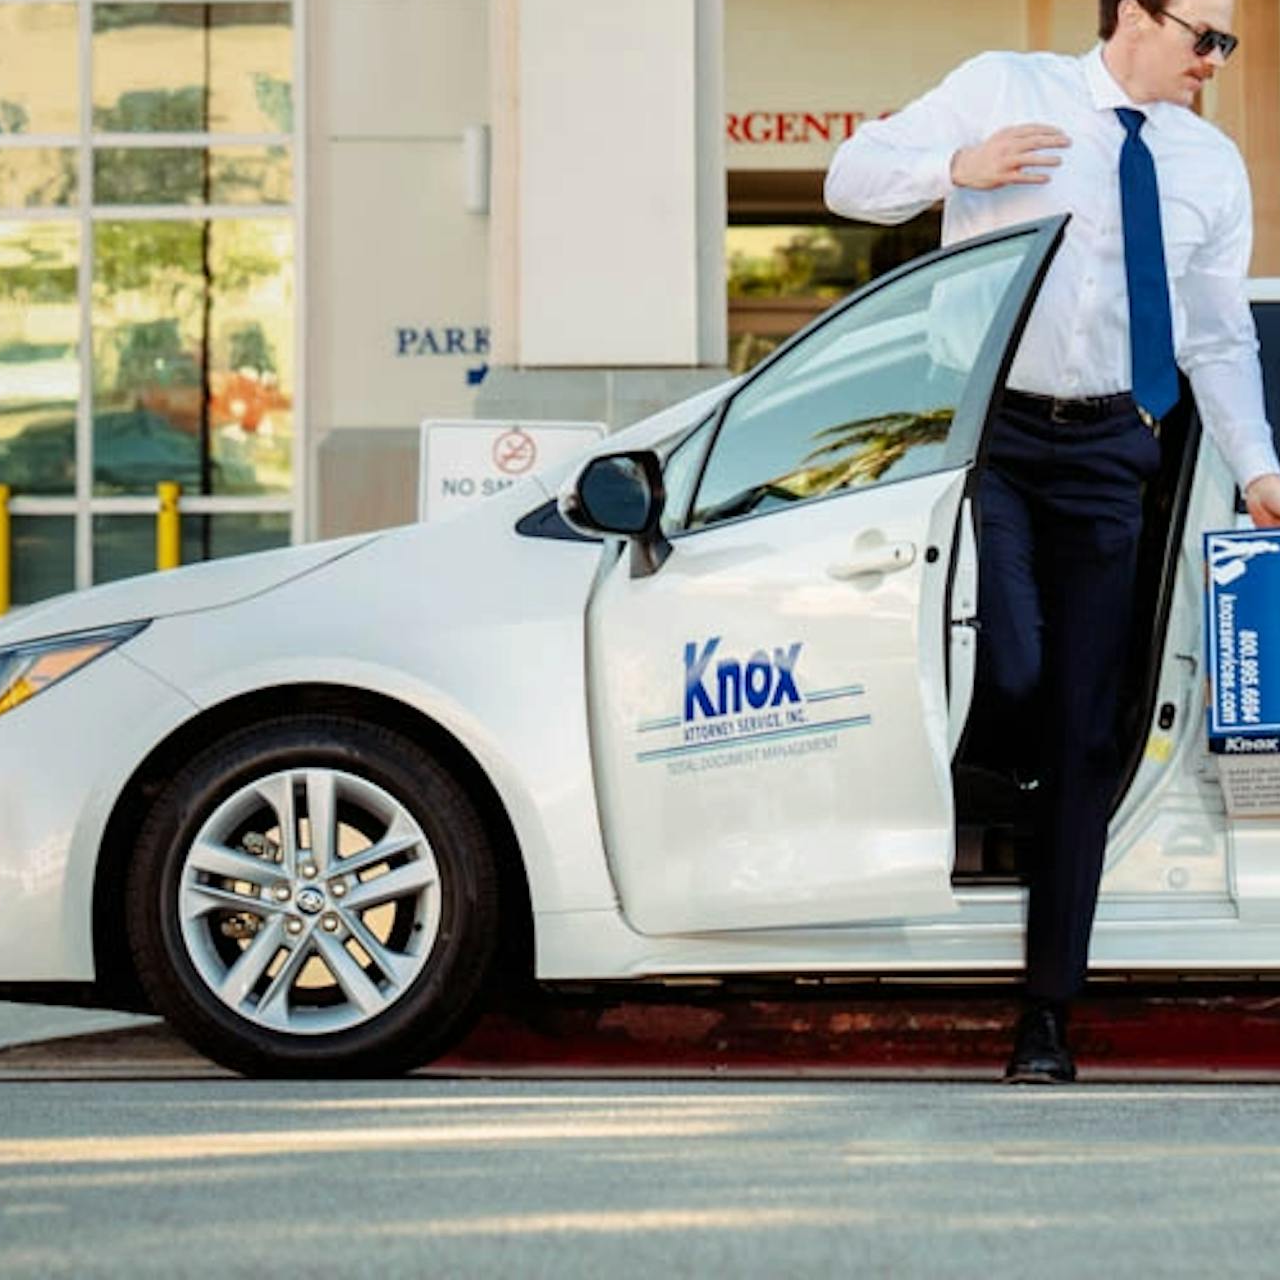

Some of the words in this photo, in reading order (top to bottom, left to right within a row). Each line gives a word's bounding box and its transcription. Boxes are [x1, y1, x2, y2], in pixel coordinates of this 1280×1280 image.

[443, 478, 475, 496] NO
[683, 637, 802, 722] Knox
[683, 722, 735, 742] ATTORNEY
[1225, 736, 1280, 752] Knox
